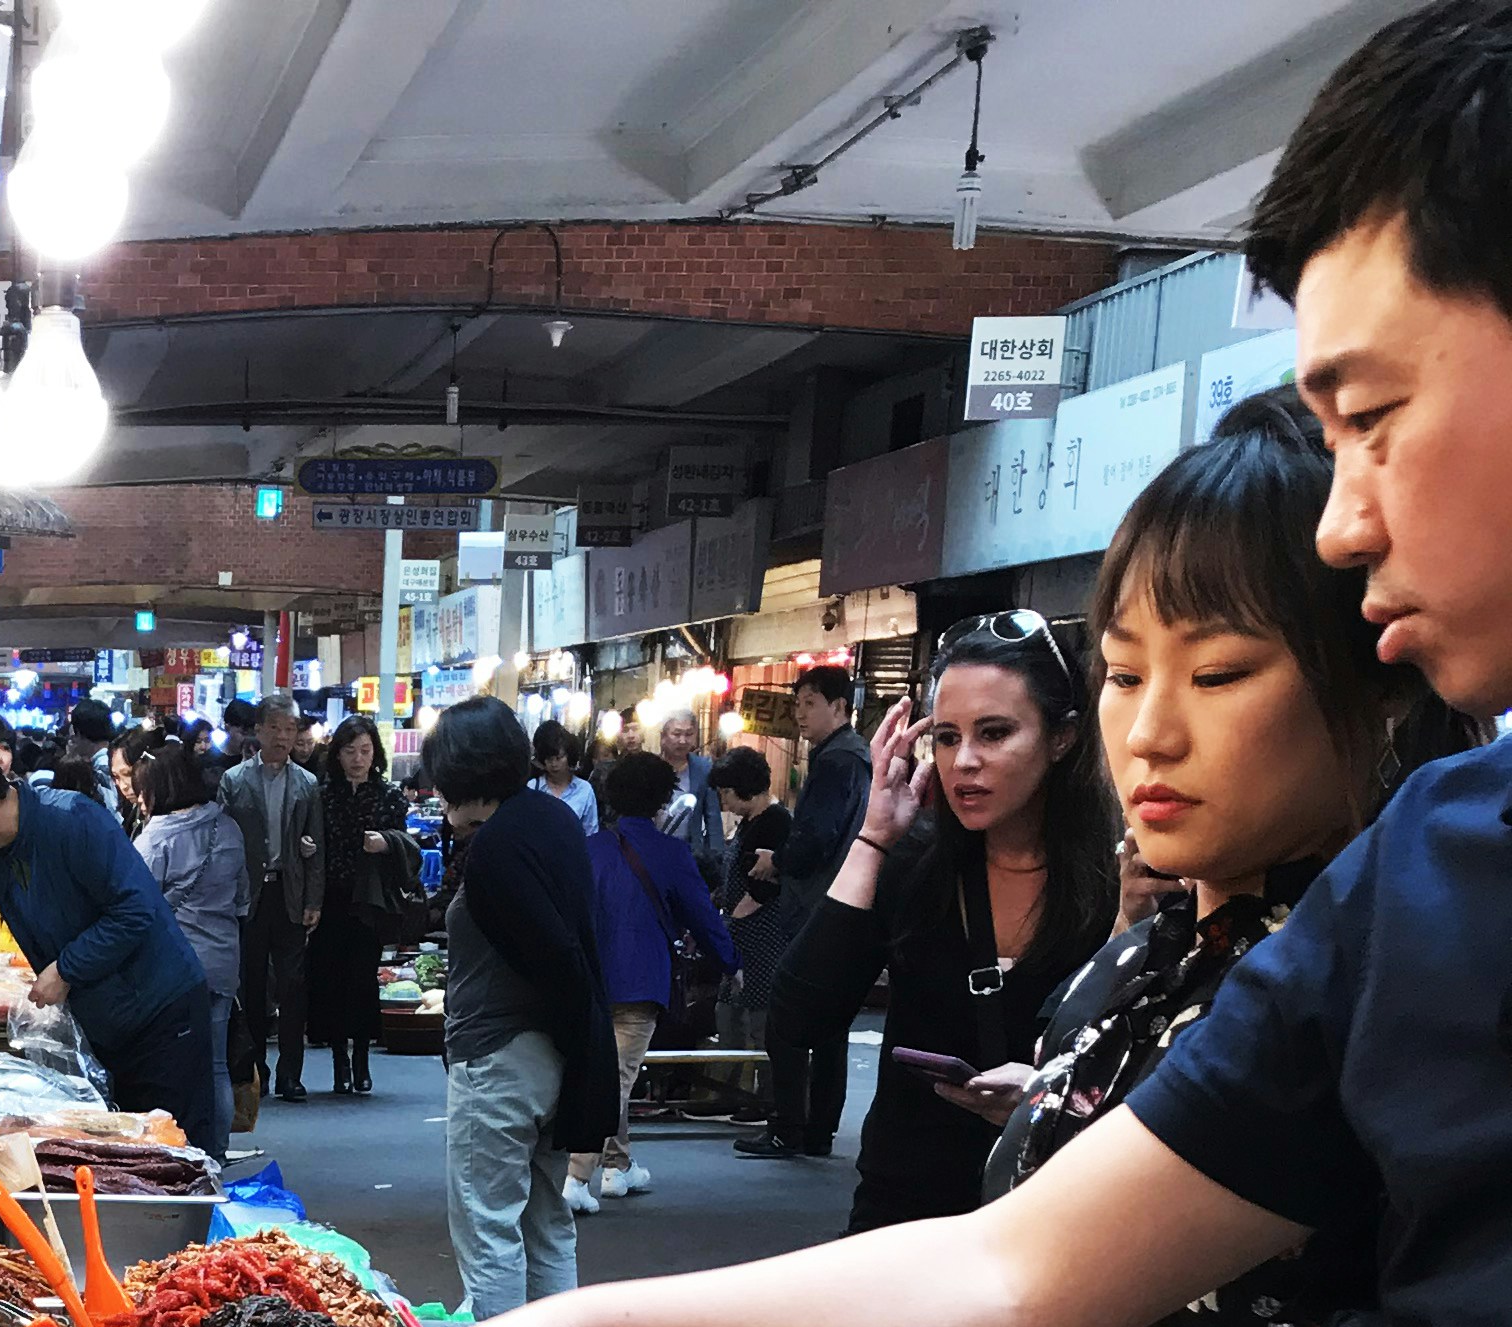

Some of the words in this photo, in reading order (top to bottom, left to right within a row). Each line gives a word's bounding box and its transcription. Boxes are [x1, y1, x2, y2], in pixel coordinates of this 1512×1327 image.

[980, 338, 1055, 361] 대한상회
[983, 370, 1046, 382] 2265-4022
[990, 391, 1034, 412] 40호
[1209, 375, 1234, 408] 39호
[984, 437, 1082, 525] 대한상회
[514, 555, 539, 567] 43호
